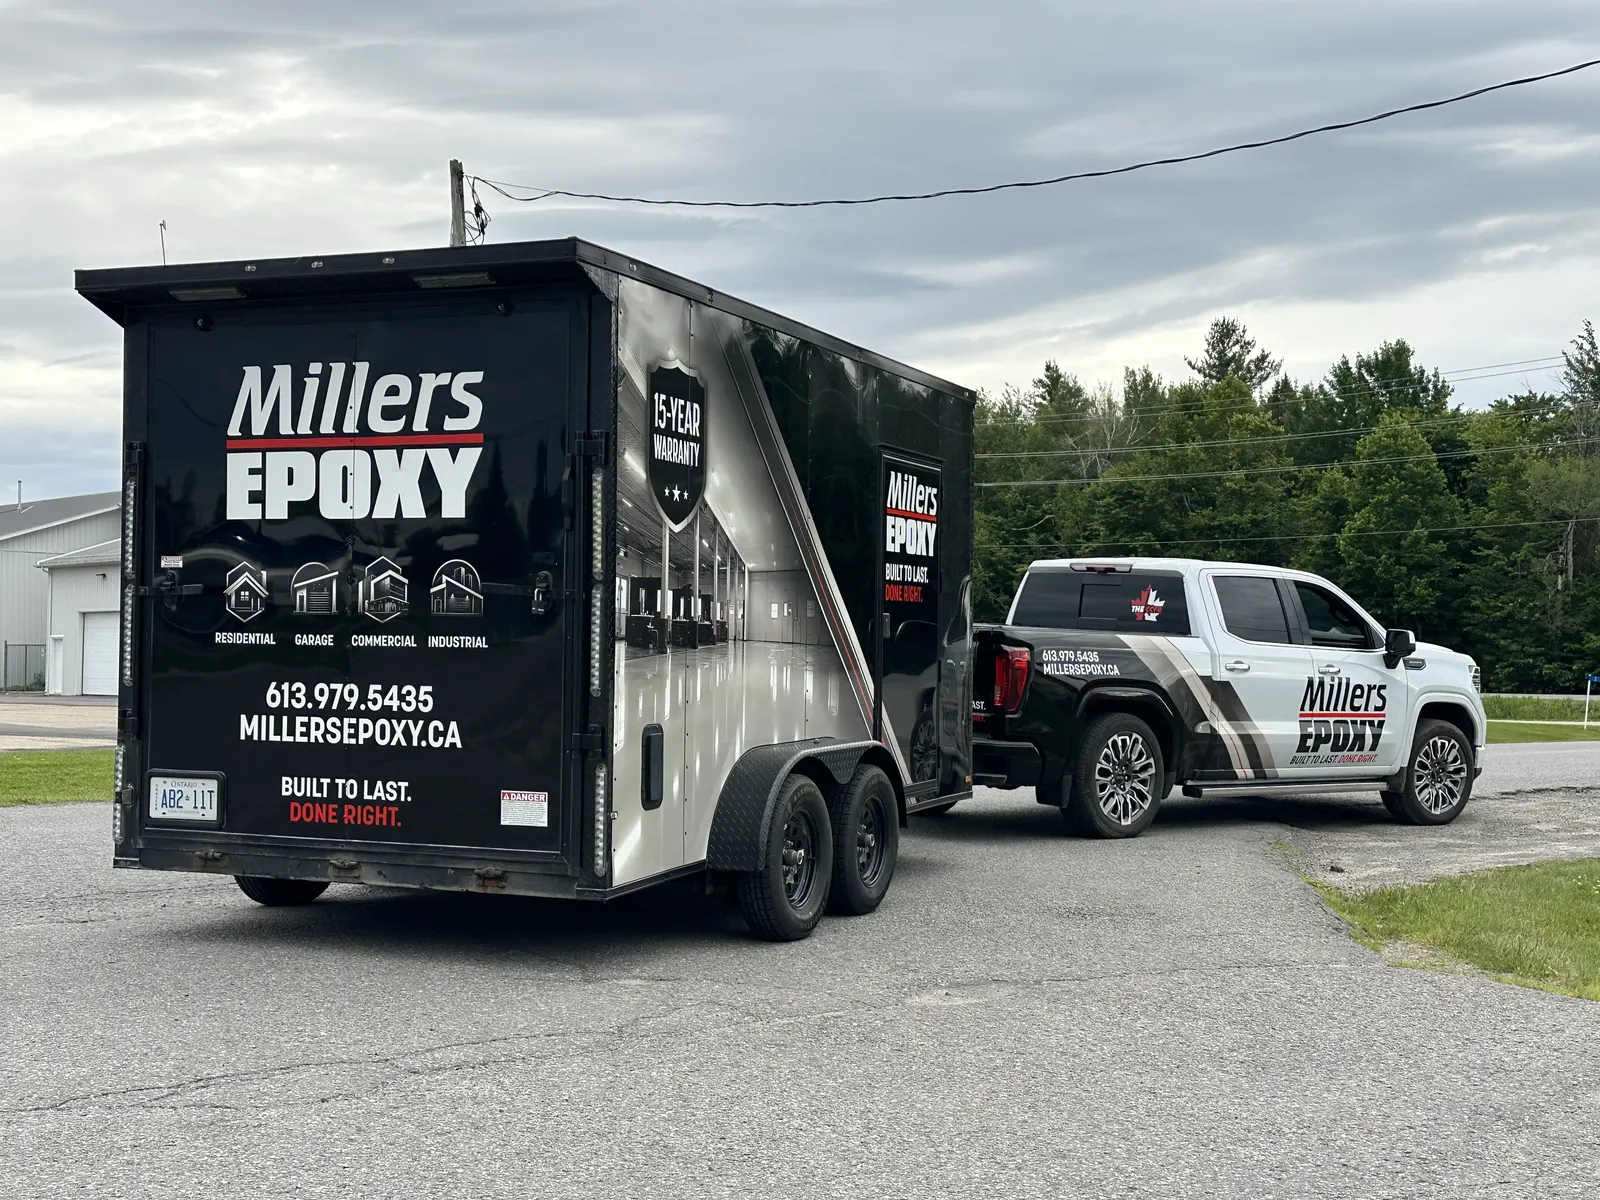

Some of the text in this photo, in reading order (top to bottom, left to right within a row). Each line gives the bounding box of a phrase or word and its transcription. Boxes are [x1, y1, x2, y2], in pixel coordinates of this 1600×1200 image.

[227, 361, 484, 436] Millers
[653, 392, 700, 437] 15-YEAR
[653, 433, 700, 467] WARRANTY
[226, 447, 484, 520] EPOXY
[887, 470, 938, 516] Millers
[886, 515, 937, 557] EPOXY
[885, 562, 929, 583] BUILT TO LAST.
[885, 583, 923, 603] DONE RIGHT.
[1131, 605, 1145, 613] THE
[215, 632, 276, 645] RESIDENTIAL
[294, 633, 334, 646] GARAGE
[351, 634, 417, 647] COMMERCIAL
[427, 635, 489, 648] INDUSTRIAL
[1042, 650, 1099, 662] 613.979.5435
[1043, 663, 1120, 676] MILLERSEPOXY.CA
[265, 681, 434, 713] 613.979.5435
[970, 700, 986, 710] AST.
[1299, 676, 1387, 712] Millers
[239, 714, 462, 749] MILLERSEPOXY.CA
[1295, 719, 1386, 753] EPOXY
[1290, 755, 1311, 764] BUILT
[1310, 755, 1321, 764] TO
[1319, 755, 1338, 763] LAST.
[1337, 754, 1358, 763] DONE
[161, 788, 215, 810] AB2 11T
[281, 776, 412, 802] BUILT TO LAST.
[510, 793, 546, 802] DANGER
[289, 801, 402, 827] DONE RIGHT.
